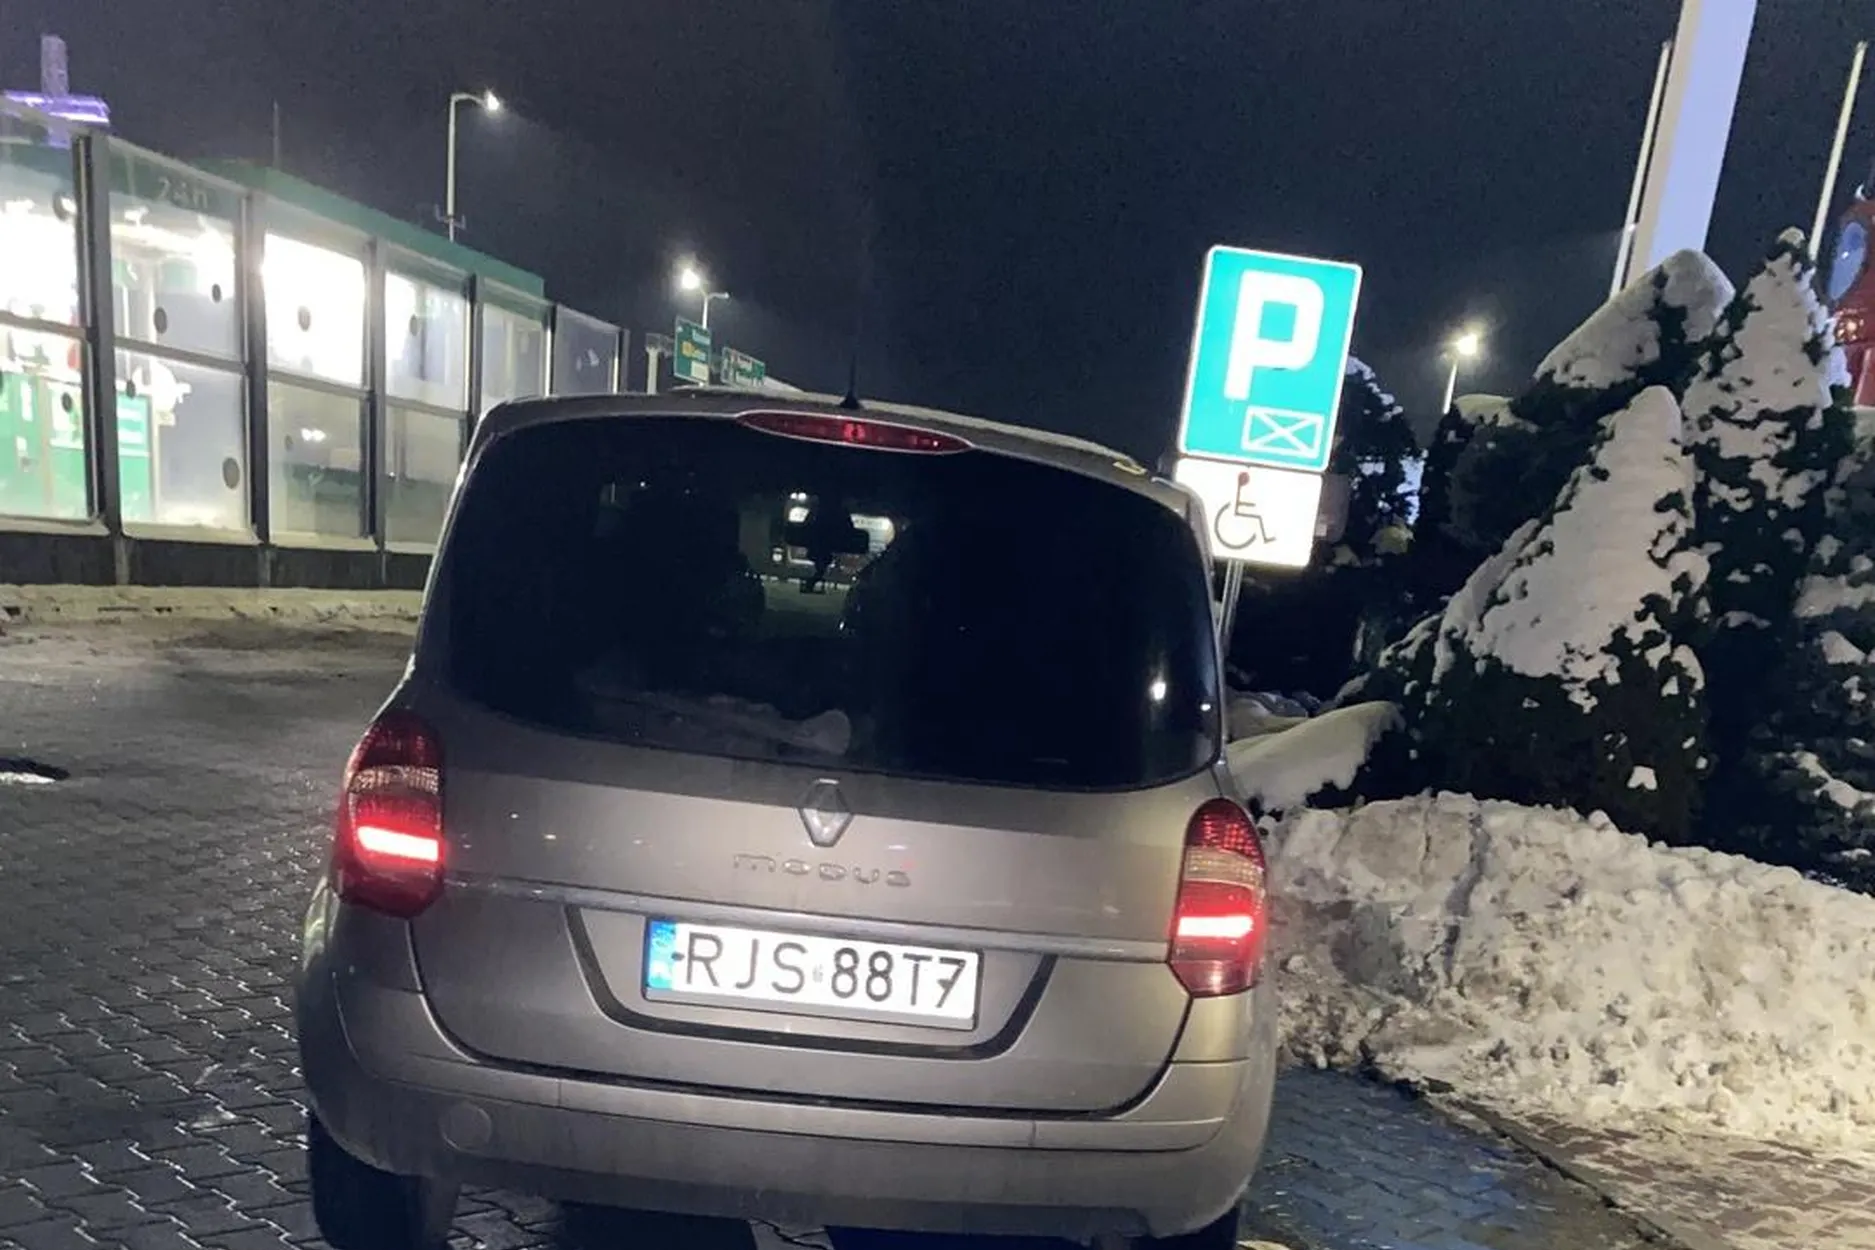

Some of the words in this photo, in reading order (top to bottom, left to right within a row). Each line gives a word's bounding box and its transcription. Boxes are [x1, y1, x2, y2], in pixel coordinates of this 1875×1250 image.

[1223, 269, 1325, 401] P
[685, 931, 808, 994] RJS
[830, 946, 967, 1009] 88T7
